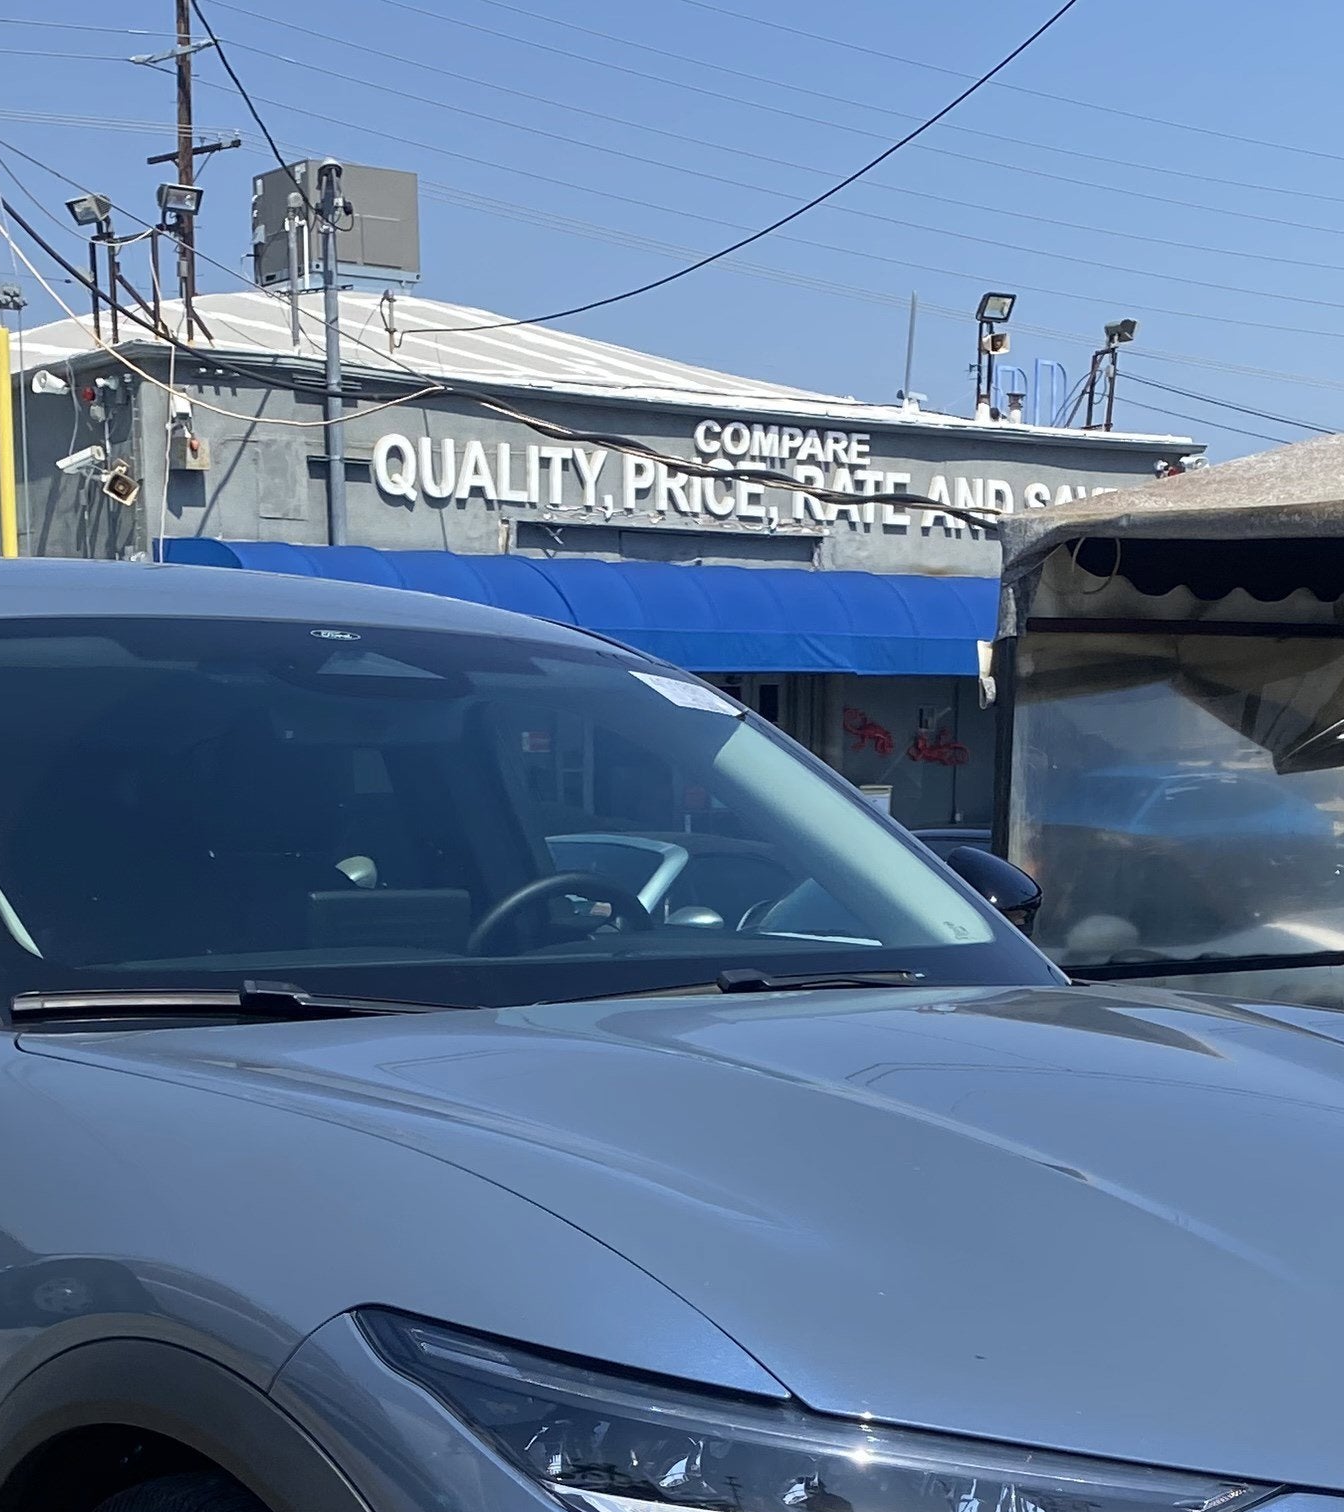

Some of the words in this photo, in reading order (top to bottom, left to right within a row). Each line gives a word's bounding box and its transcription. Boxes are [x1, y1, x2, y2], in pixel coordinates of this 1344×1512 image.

[693, 419, 871, 466] COMPARE
[373, 433, 614, 518] QUALITY,
[792, 464, 911, 526] RATE
[921, 475, 1015, 530] AND
